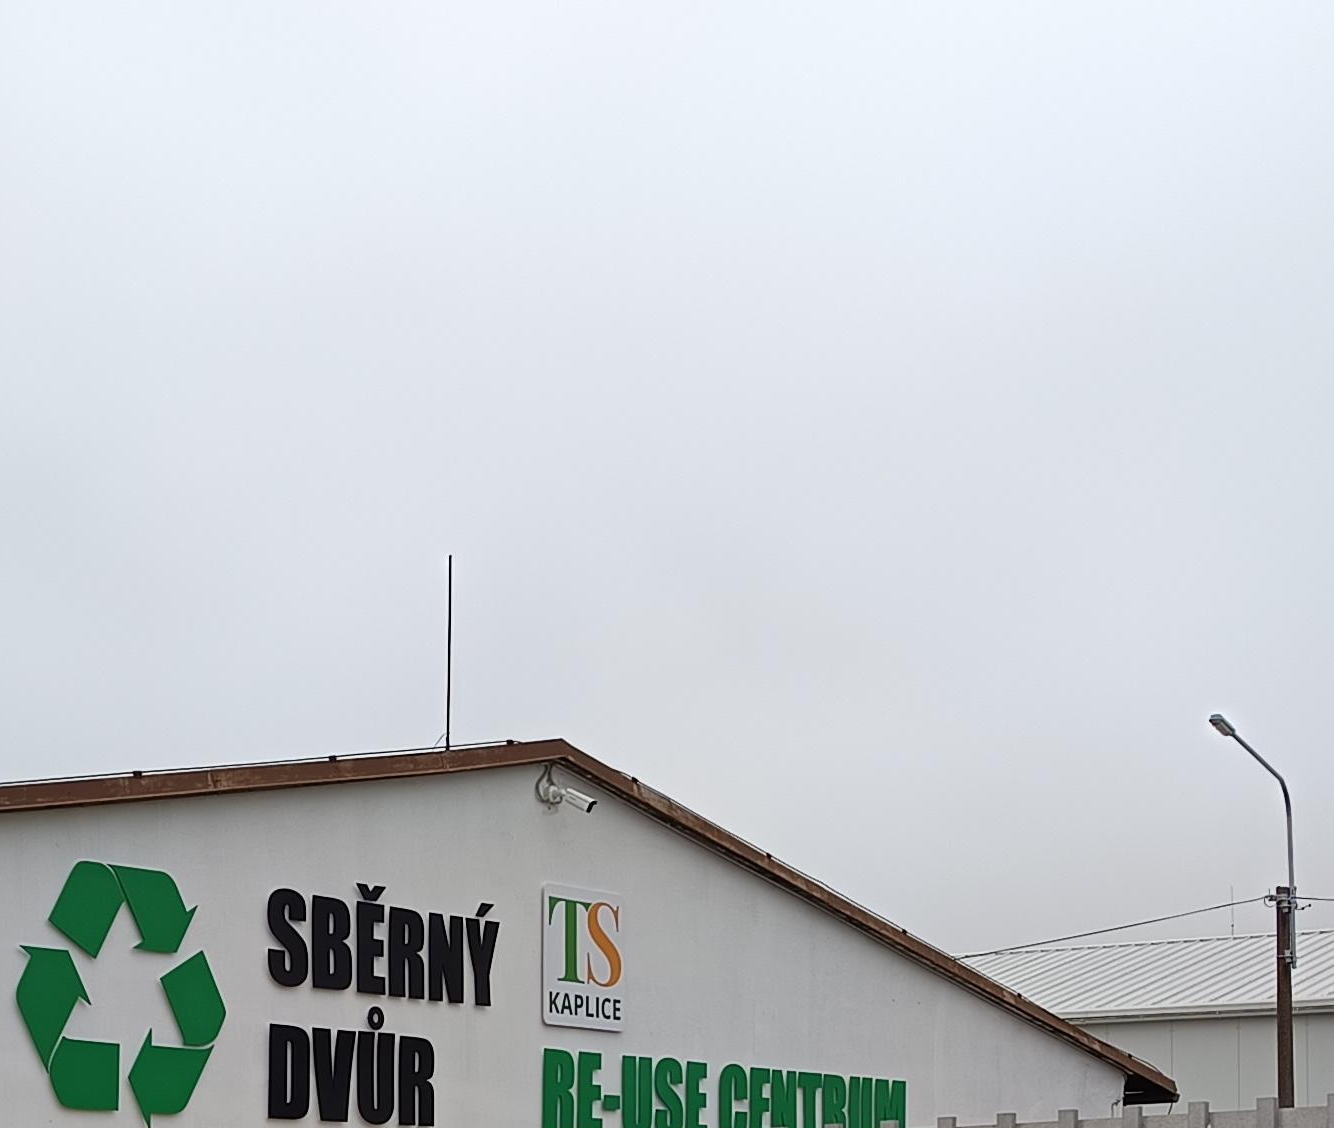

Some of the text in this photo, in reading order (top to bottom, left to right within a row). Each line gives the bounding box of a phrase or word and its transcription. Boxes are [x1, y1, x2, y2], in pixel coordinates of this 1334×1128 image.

[267, 883, 501, 1007] SBĚRNÝ
[548, 896, 623, 989] TS
[548, 991, 622, 1021] KAPLICE
[267, 1006, 436, 1128] DVŮR
